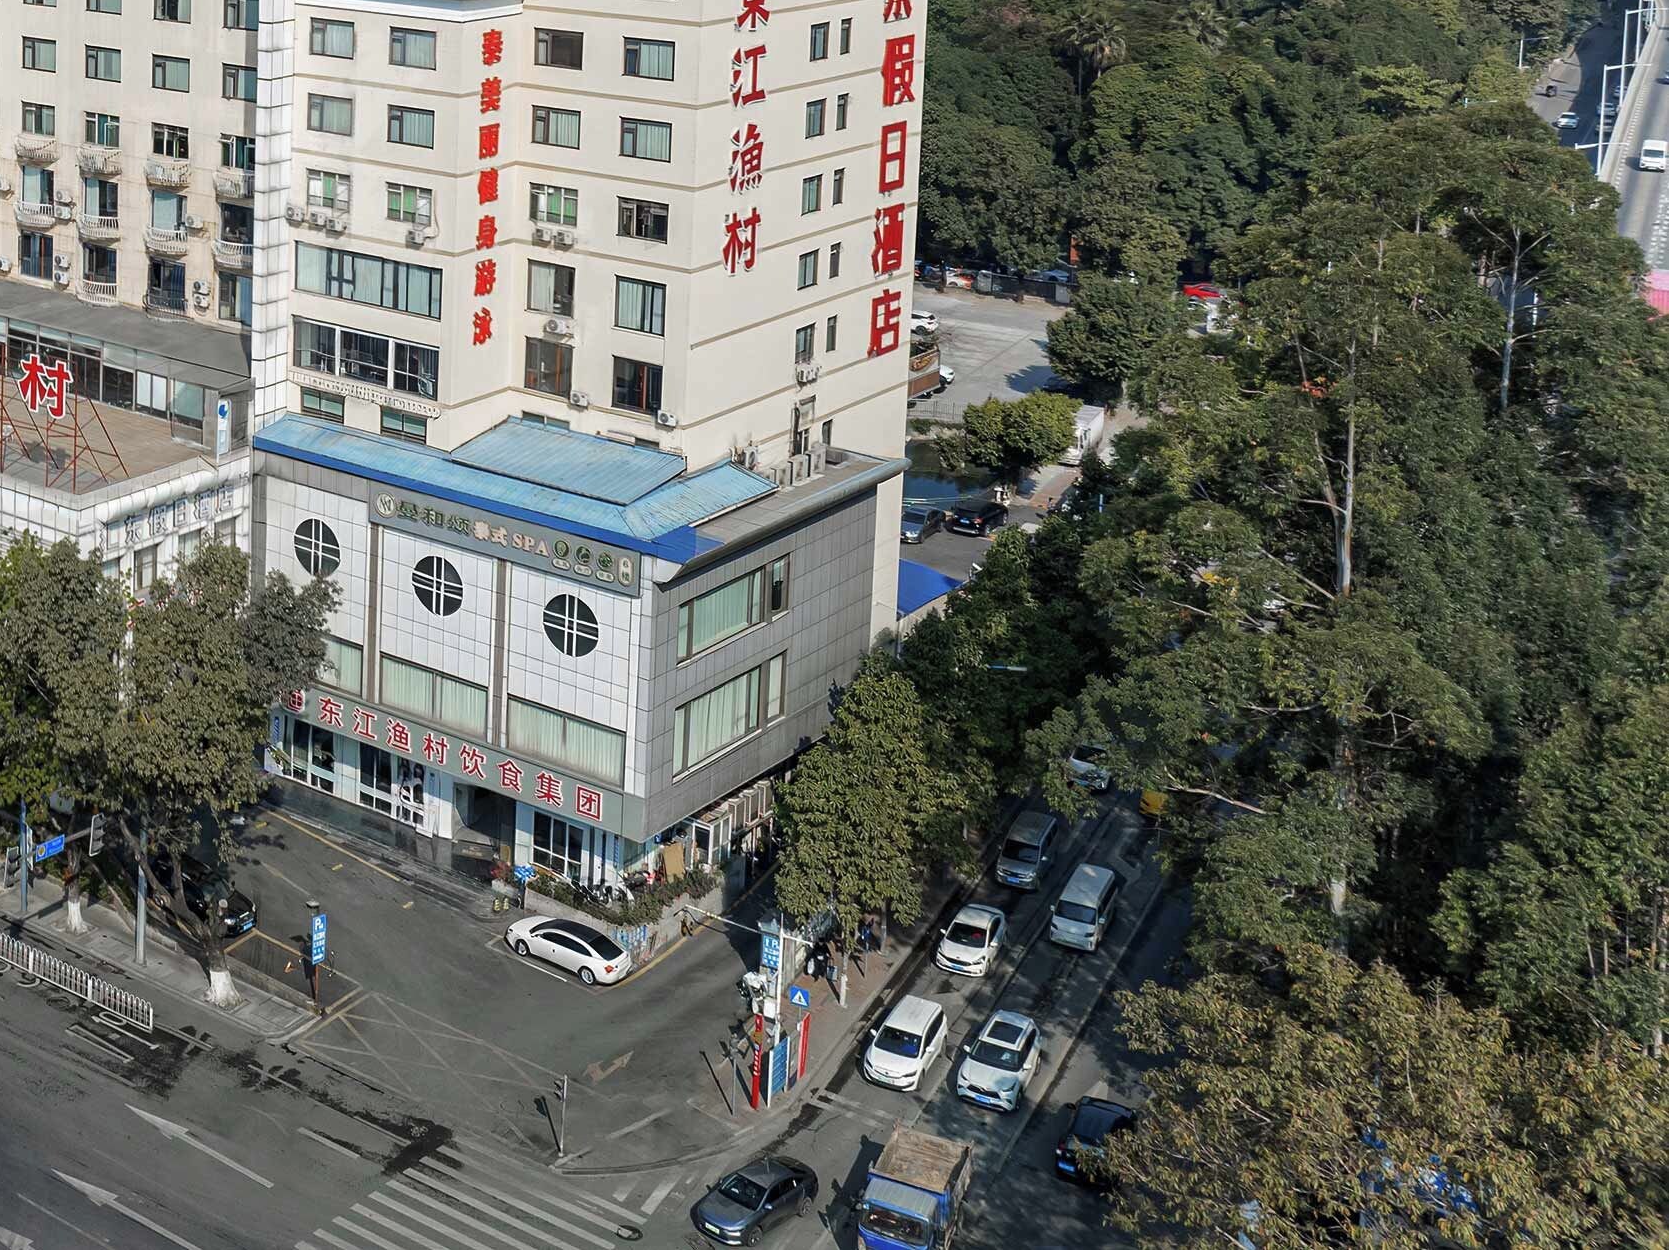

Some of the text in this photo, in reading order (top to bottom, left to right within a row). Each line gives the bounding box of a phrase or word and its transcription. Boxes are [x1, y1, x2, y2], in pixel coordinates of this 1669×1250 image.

[472, 28, 503, 346] 泰美丽健身游泳
[318, 695, 604, 822] 东江渔村饮食集团
